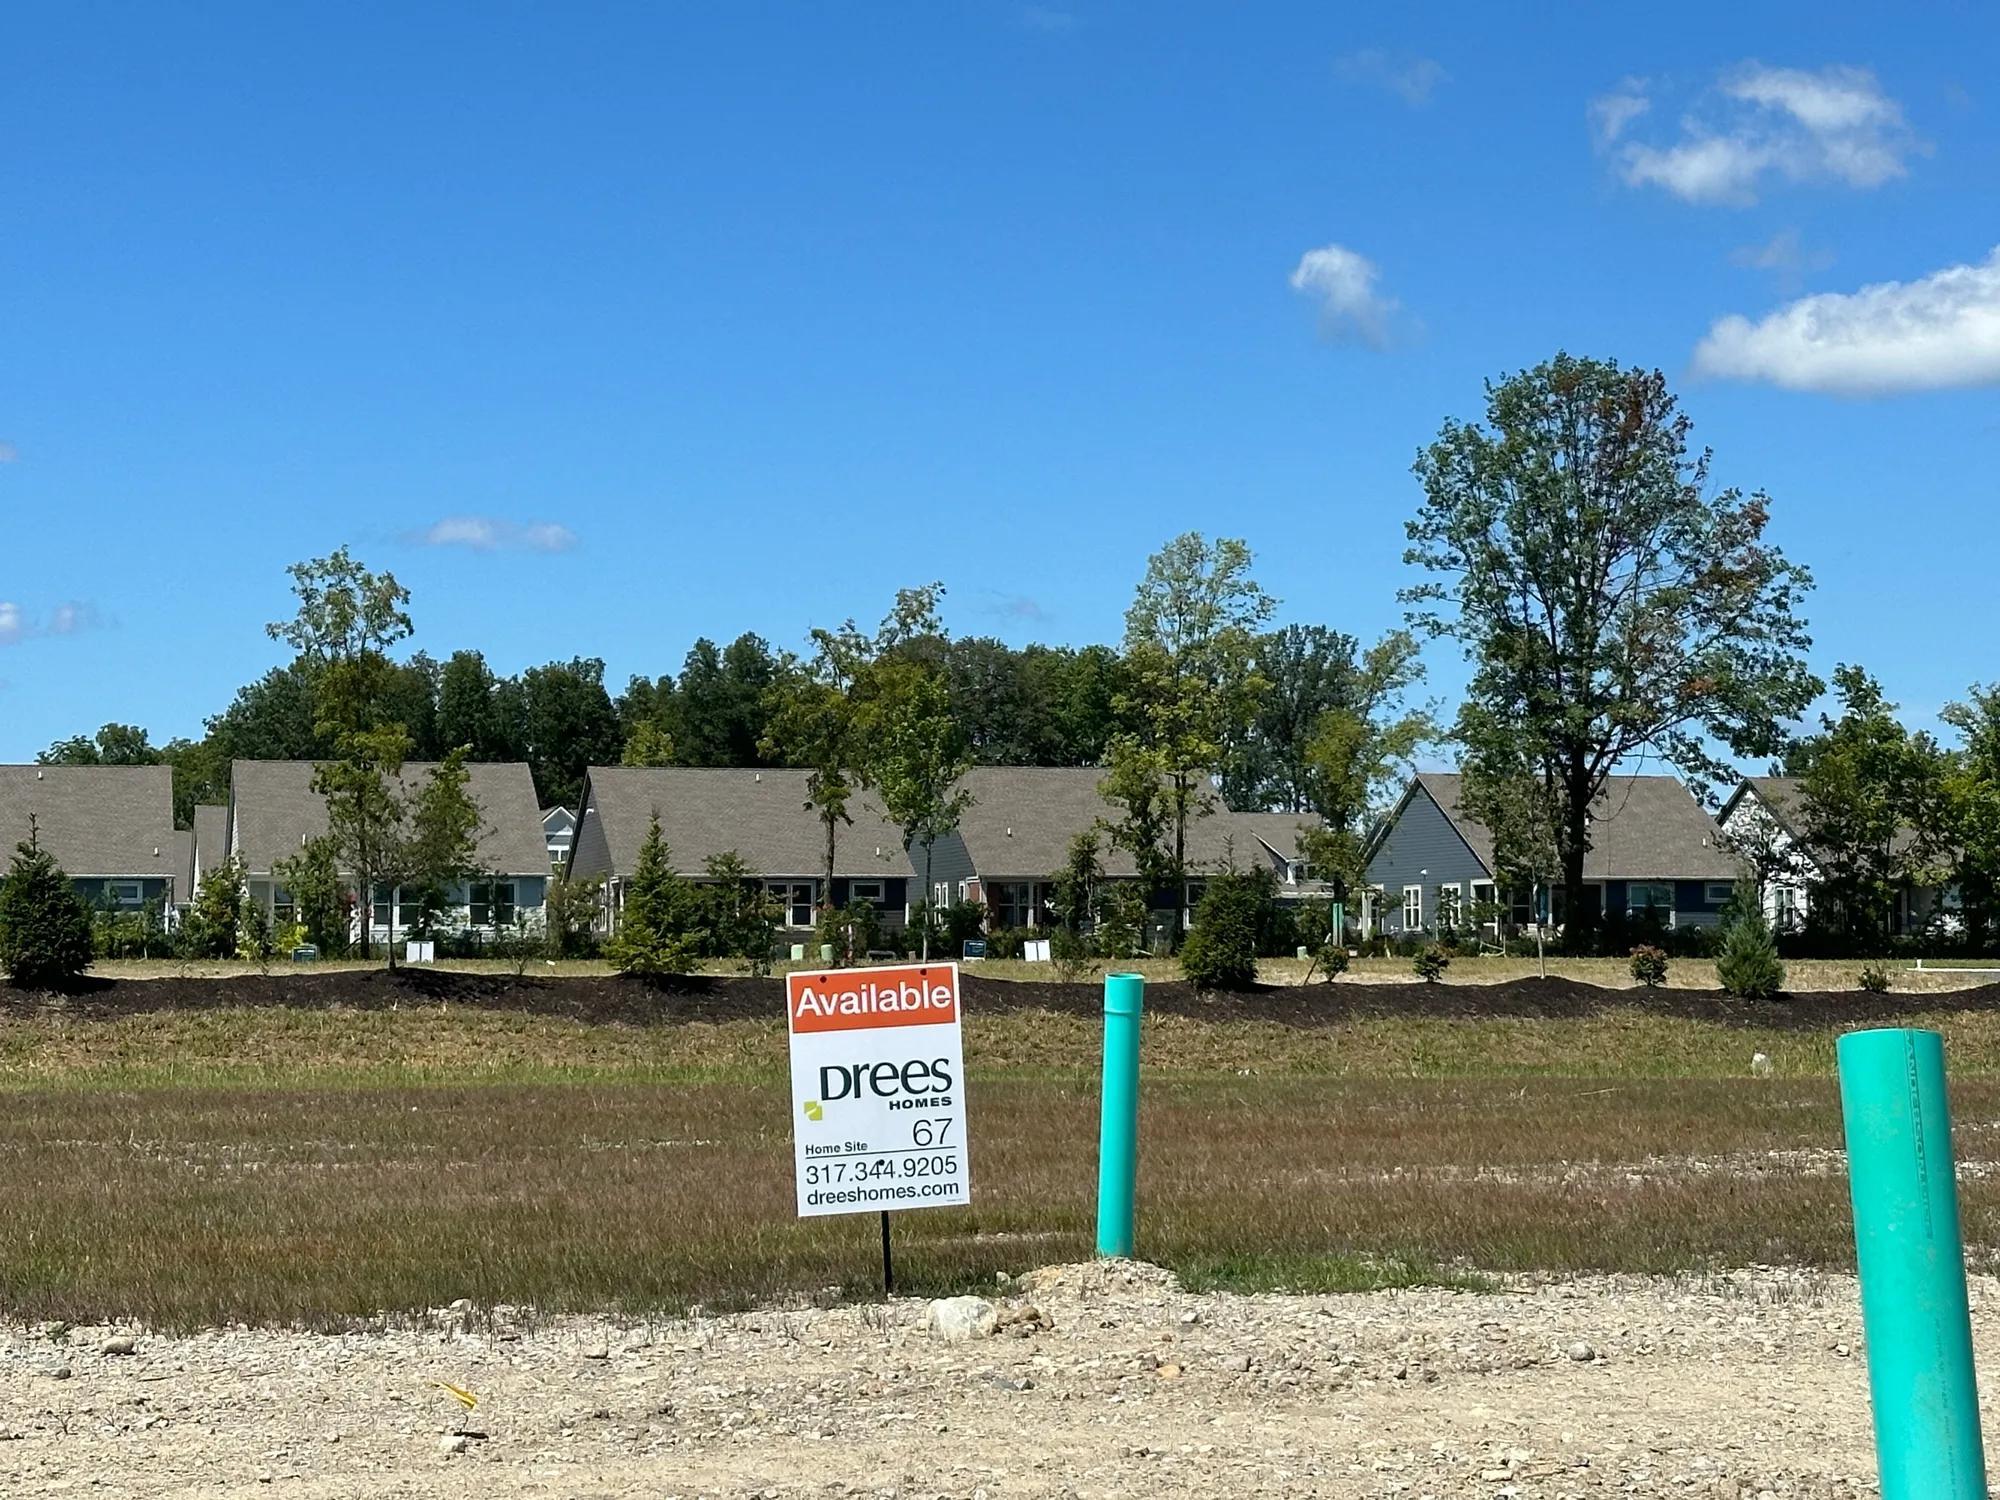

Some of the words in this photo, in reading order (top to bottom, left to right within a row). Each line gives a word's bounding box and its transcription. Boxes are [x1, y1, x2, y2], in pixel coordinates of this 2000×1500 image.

[795, 979, 952, 1018] Available
[820, 1058, 953, 1101] Drees
[889, 1096, 953, 1110] HOMES
[912, 1118, 953, 1147] 67
[805, 1143, 841, 1155] Home
[844, 1141, 868, 1153] Site
[806, 1155, 958, 1185] 317.344.9205
[807, 1181, 959, 1206] dreeshomes.com
